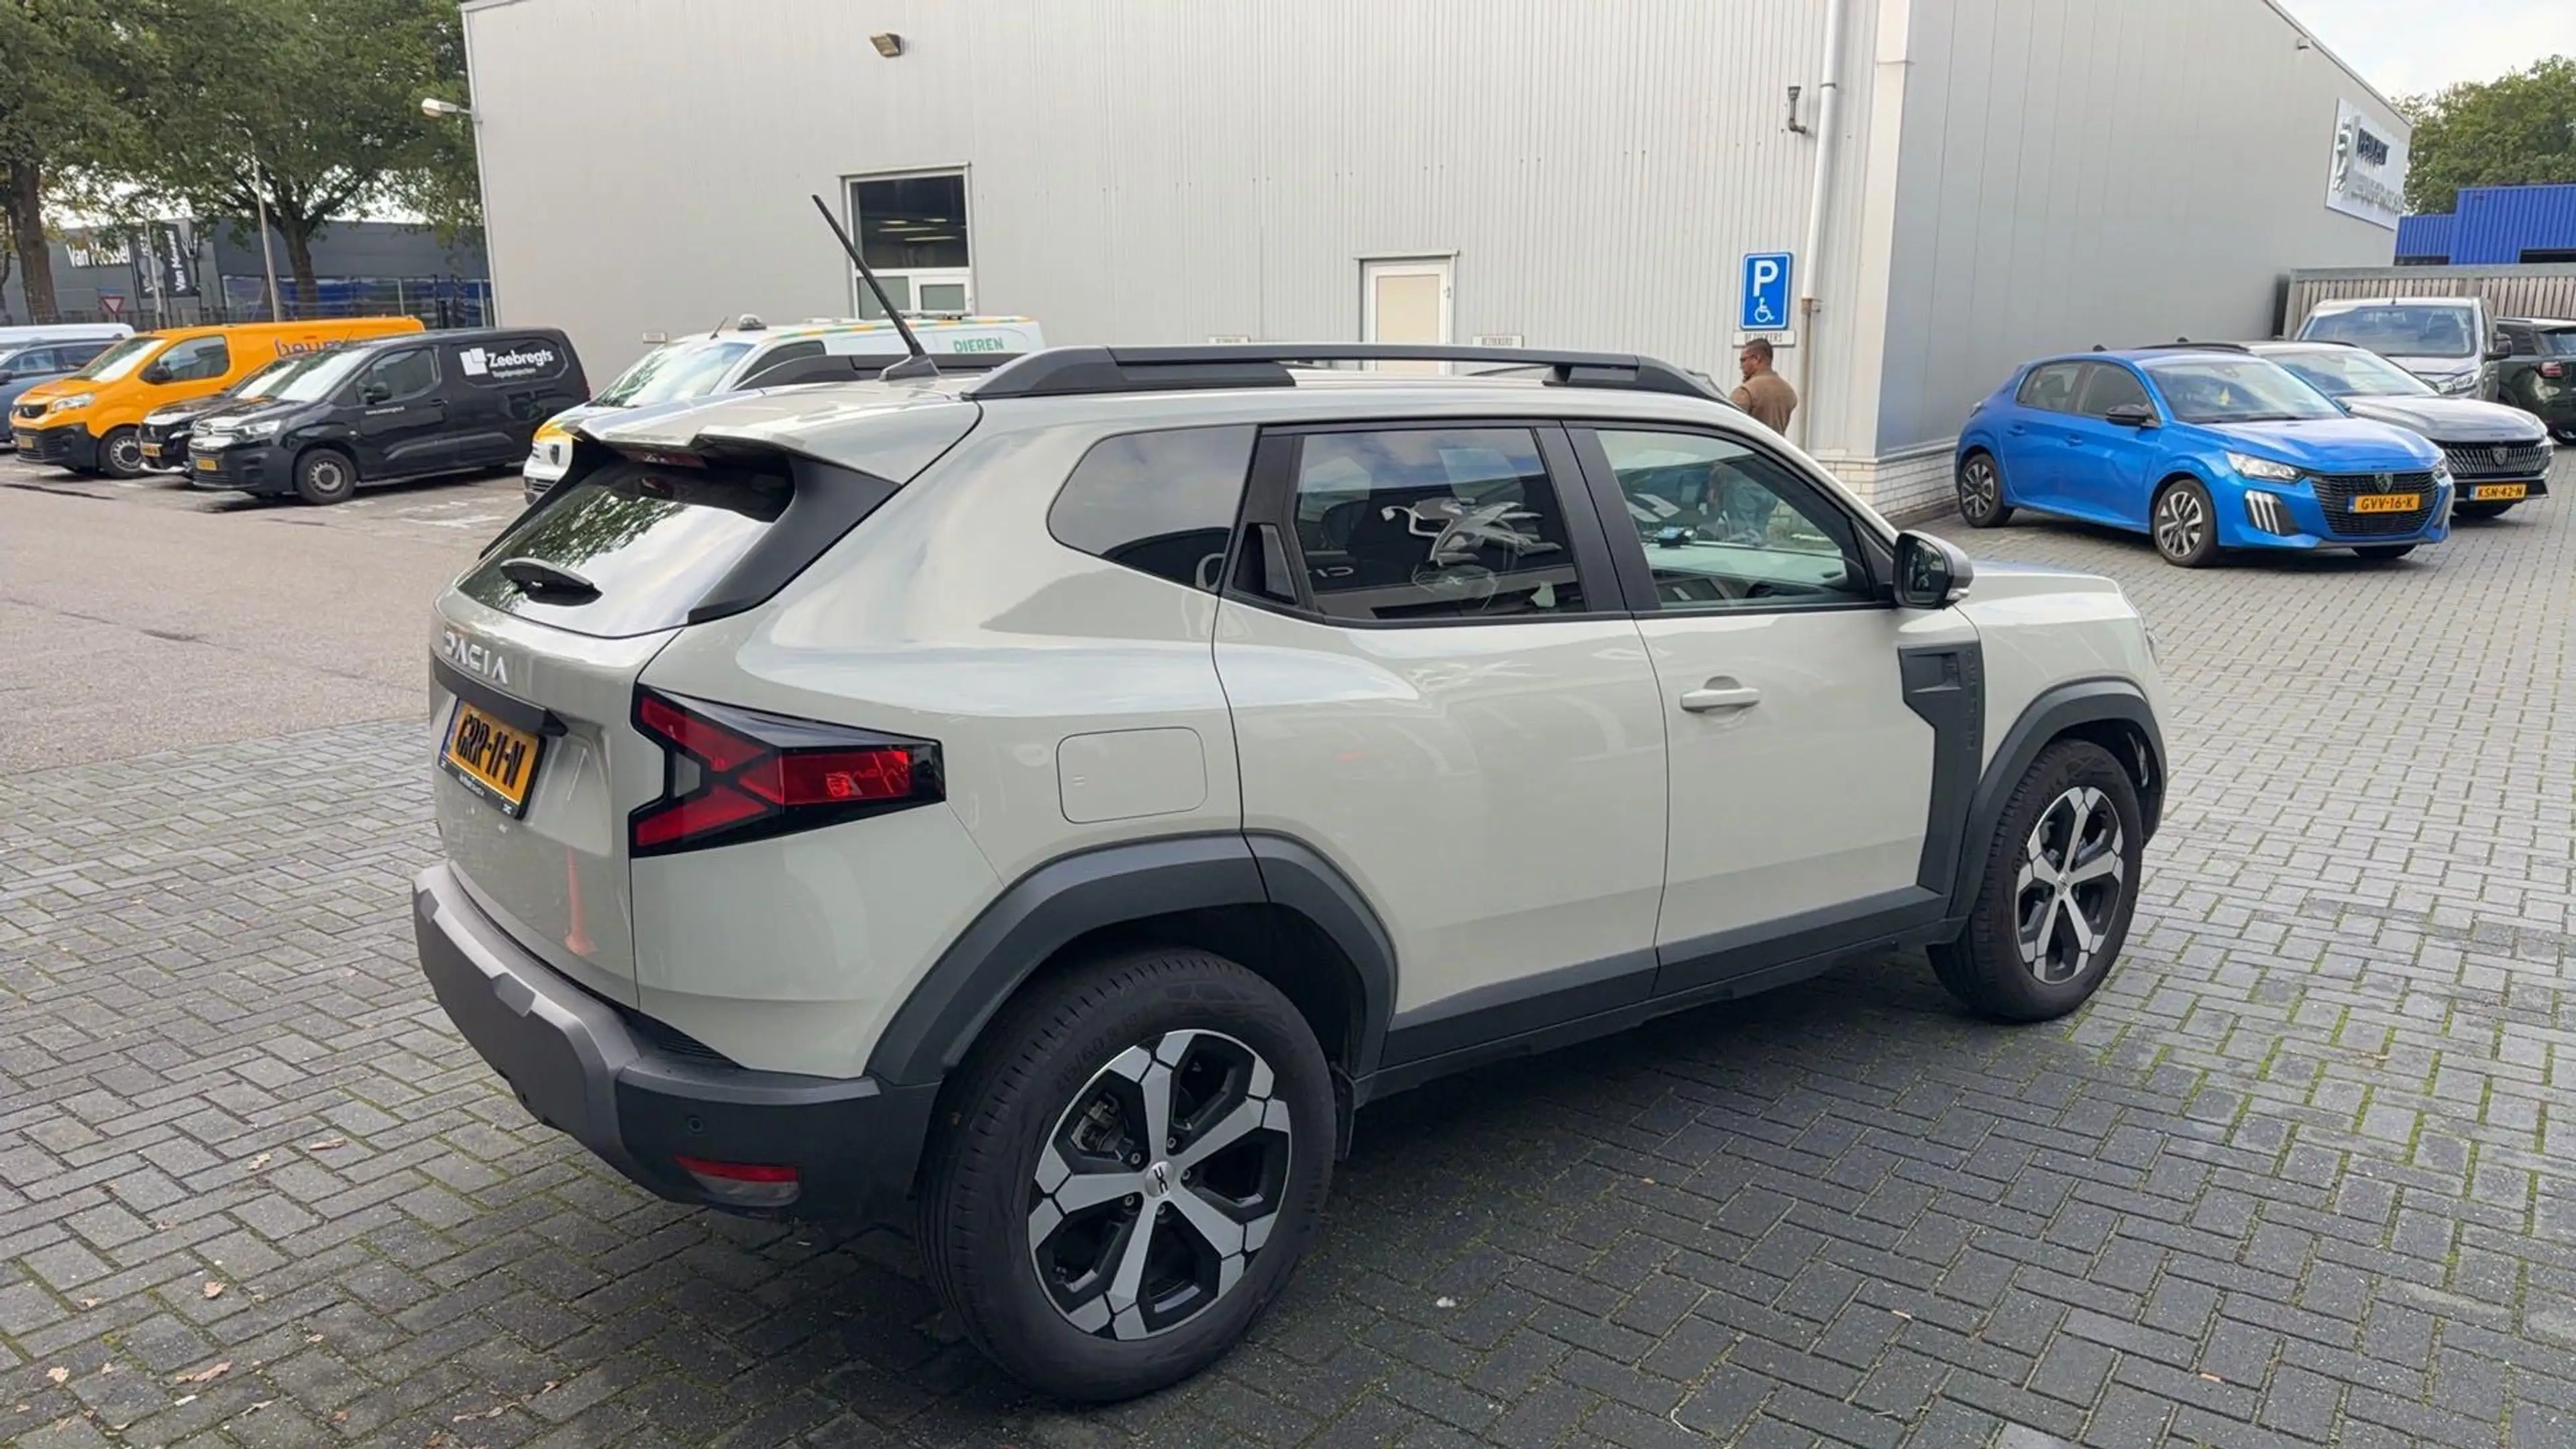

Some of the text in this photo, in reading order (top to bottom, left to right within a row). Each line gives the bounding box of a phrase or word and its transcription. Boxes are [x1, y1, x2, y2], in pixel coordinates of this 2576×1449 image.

[66, 244, 90, 268] Van
[174, 270, 187, 292] Van
[1753, 260, 1779, 297] P
[953, 337, 1004, 352] DIEREN
[486, 348, 555, 368] Zeebregts
[2477, 486, 2523, 498] KSN-42-N
[2361, 496, 2414, 511] GVV-16-K
[443, 631, 508, 685] DACIA
[456, 713, 527, 790] GRR-11-N
